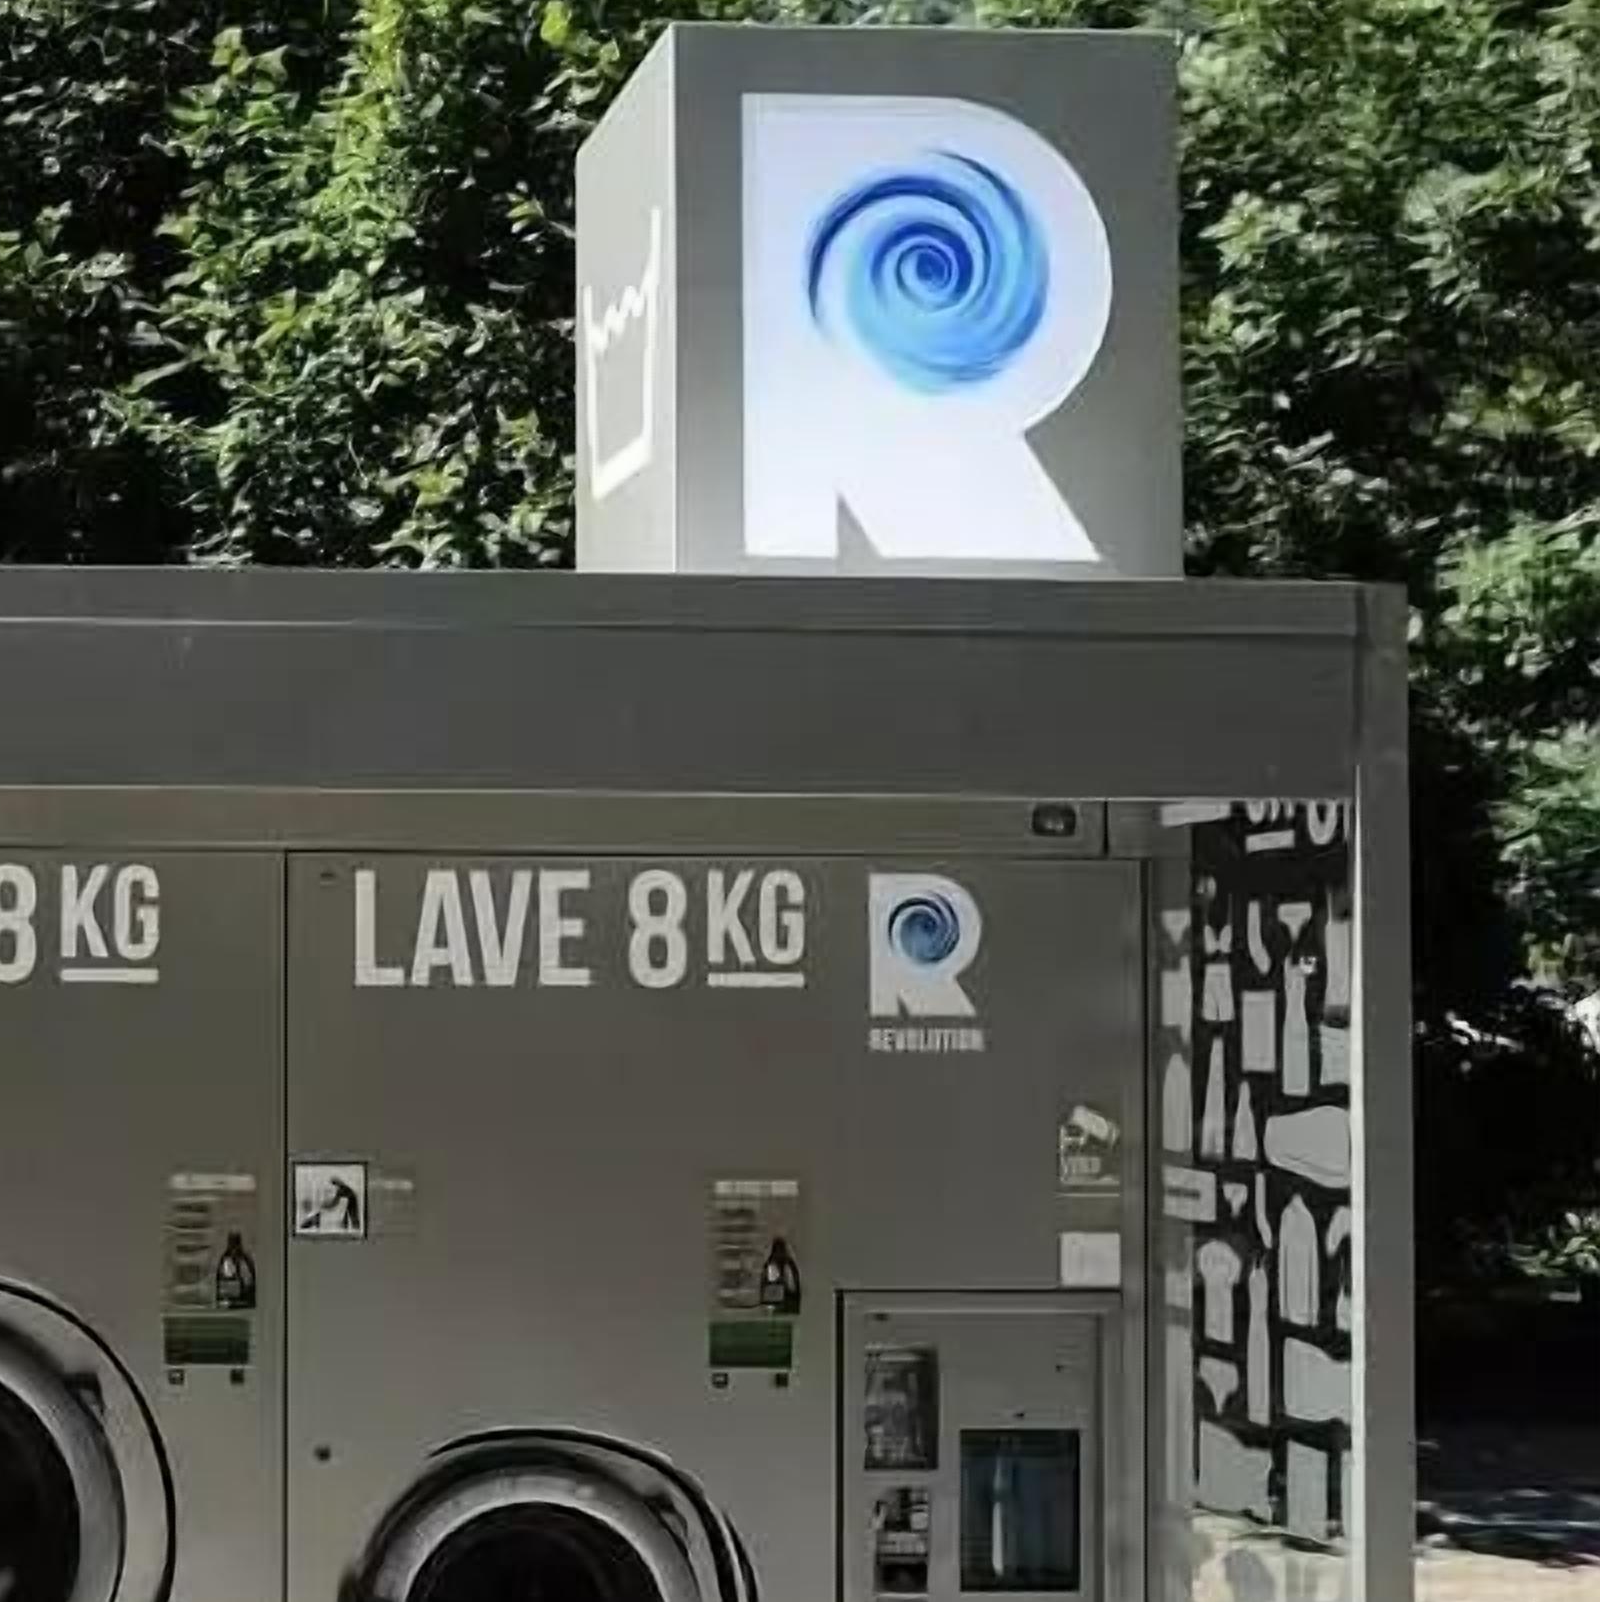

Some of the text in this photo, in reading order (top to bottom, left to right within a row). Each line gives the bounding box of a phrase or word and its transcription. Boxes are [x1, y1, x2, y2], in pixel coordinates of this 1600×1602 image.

[741, 93, 1113, 563] R
[354, 869, 592, 987] LAVE
[869, 873, 984, 1017] R
